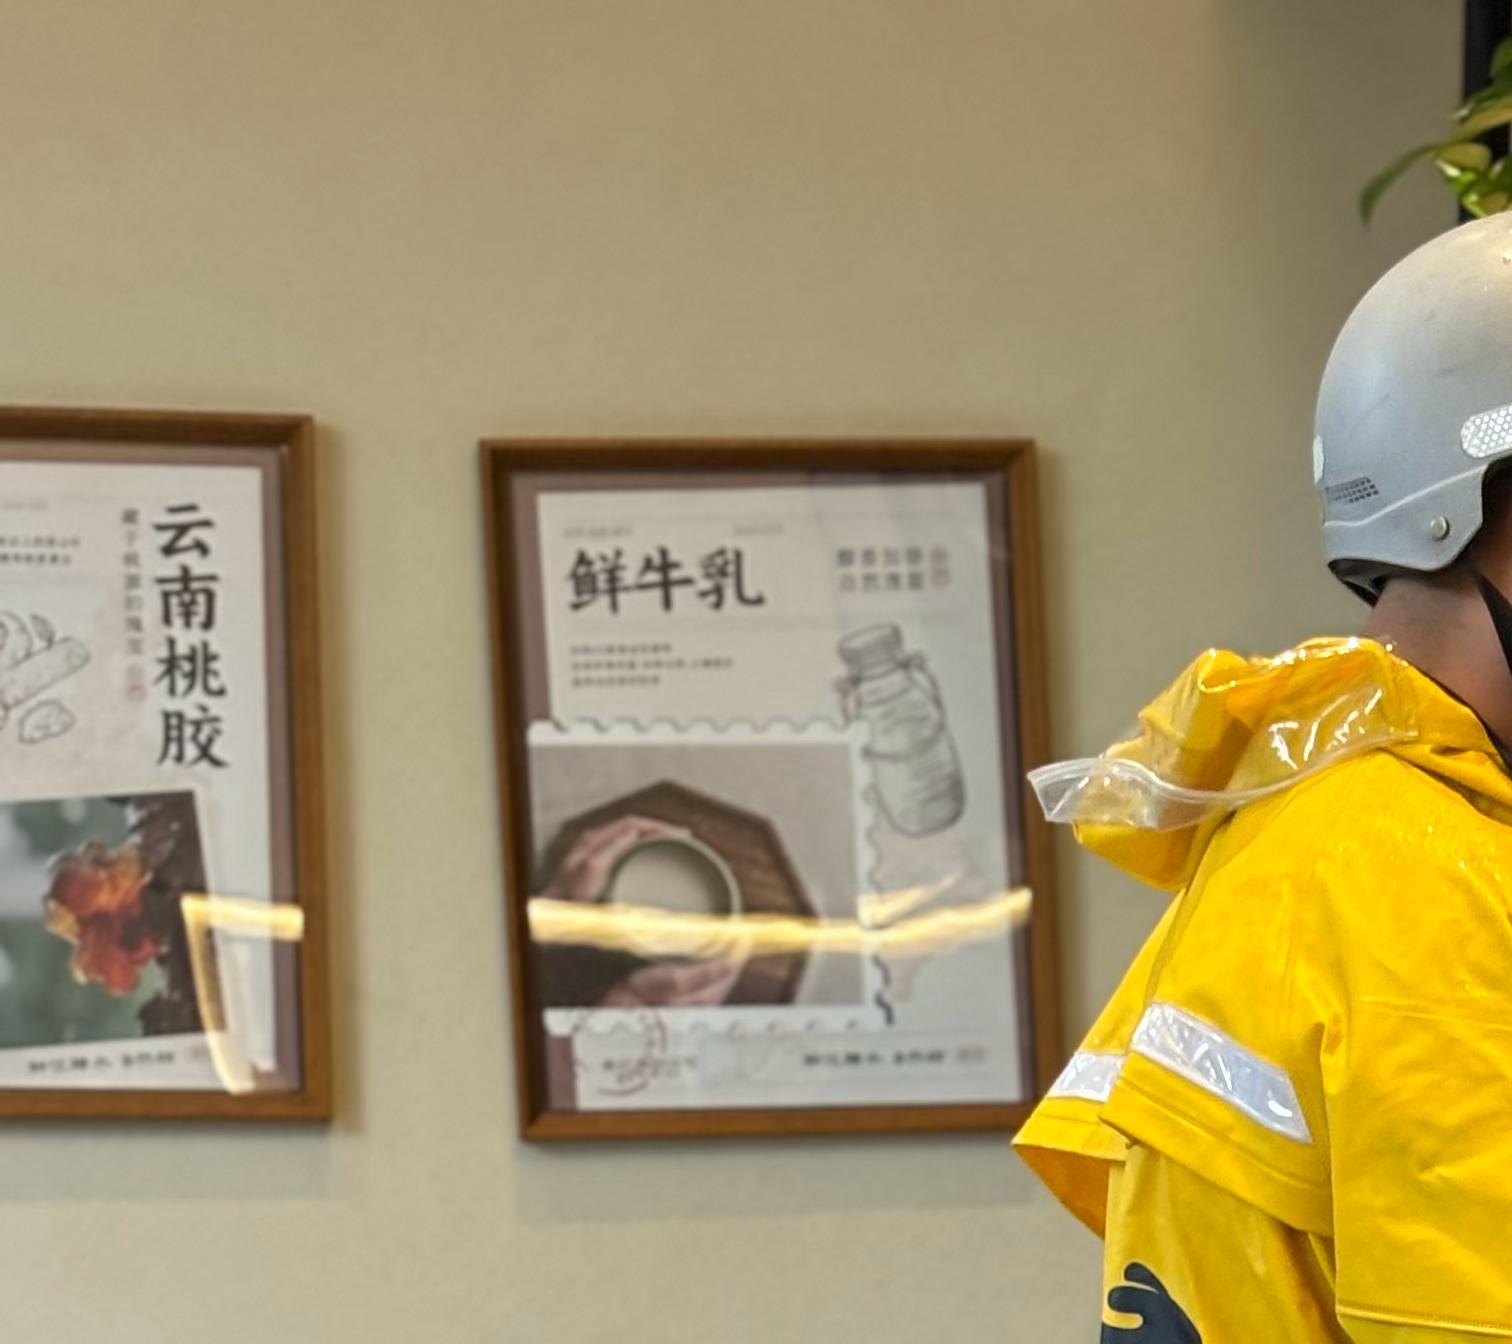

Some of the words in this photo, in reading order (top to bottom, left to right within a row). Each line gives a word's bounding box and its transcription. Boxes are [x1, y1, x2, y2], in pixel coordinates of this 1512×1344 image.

[152, 502, 230, 769] 云南桃胶
[566, 546, 766, 615] 鲜牛乳
